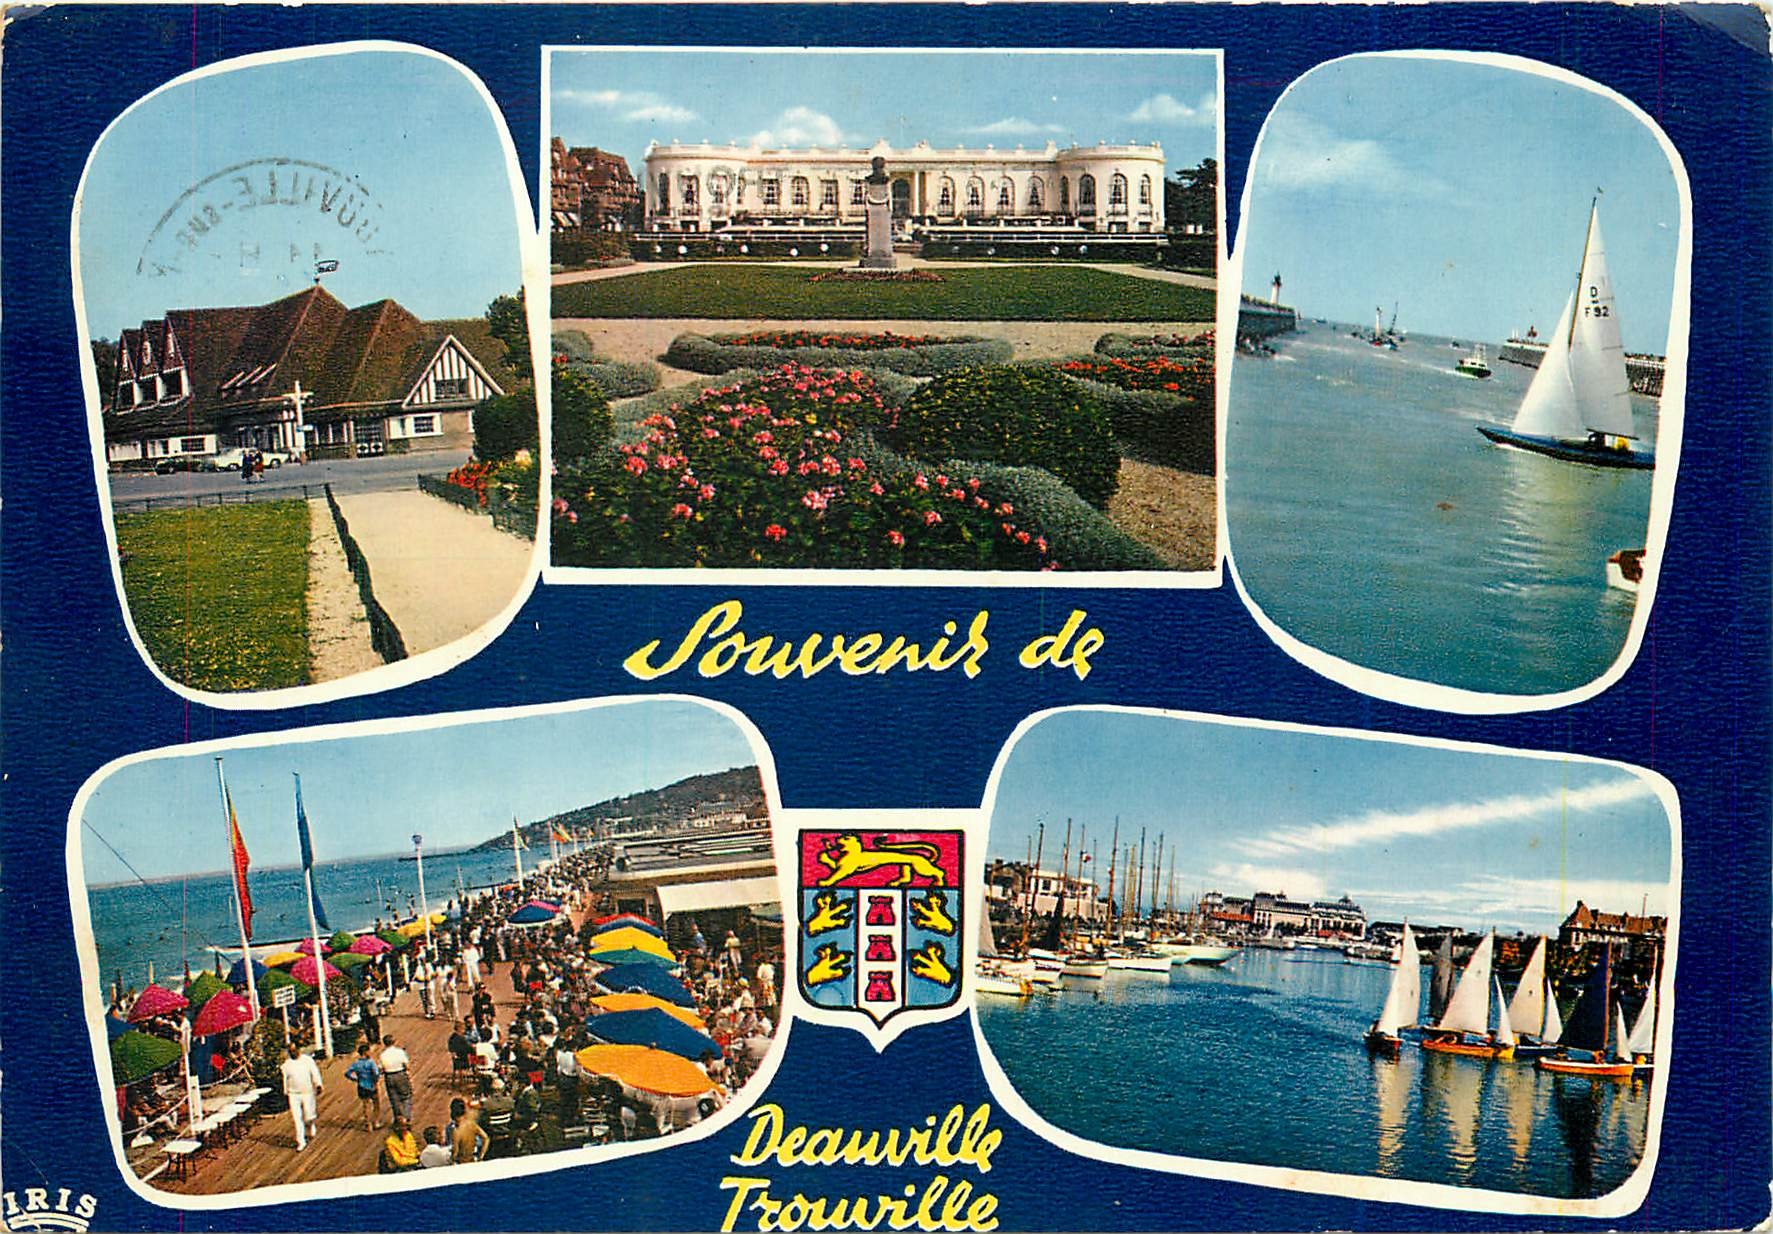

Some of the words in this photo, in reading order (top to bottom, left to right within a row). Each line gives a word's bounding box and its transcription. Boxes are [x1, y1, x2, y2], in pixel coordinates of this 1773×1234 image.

[1590, 286, 1598, 298] D
[623, 600, 989, 680] Souvenir
[1019, 609, 1105, 681] de
[730, 1103, 1003, 1173] Deauville
[3, 1187, 98, 1219] IRIS
[720, 1175, 1000, 1233] Trouville
